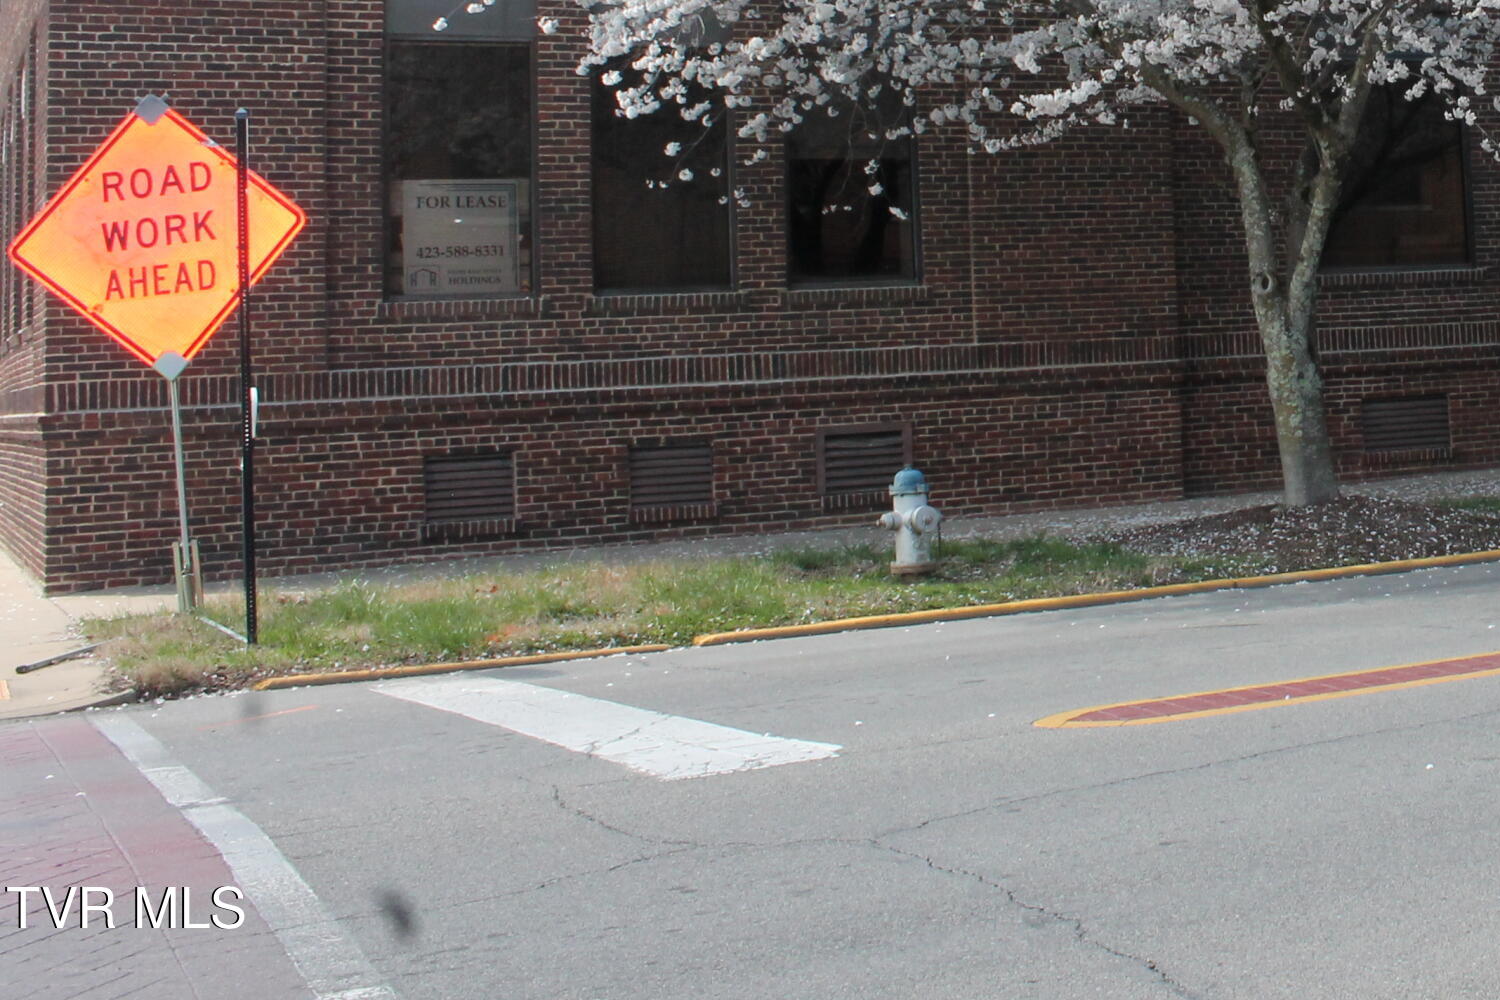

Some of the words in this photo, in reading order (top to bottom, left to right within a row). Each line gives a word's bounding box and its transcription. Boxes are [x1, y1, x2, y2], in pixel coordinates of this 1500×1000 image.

[102, 161, 213, 203] ROAD
[416, 196, 450, 209] FOR
[455, 195, 507, 209] LEASE
[101, 209, 217, 253] WORK
[105, 259, 217, 301] AHEAD
